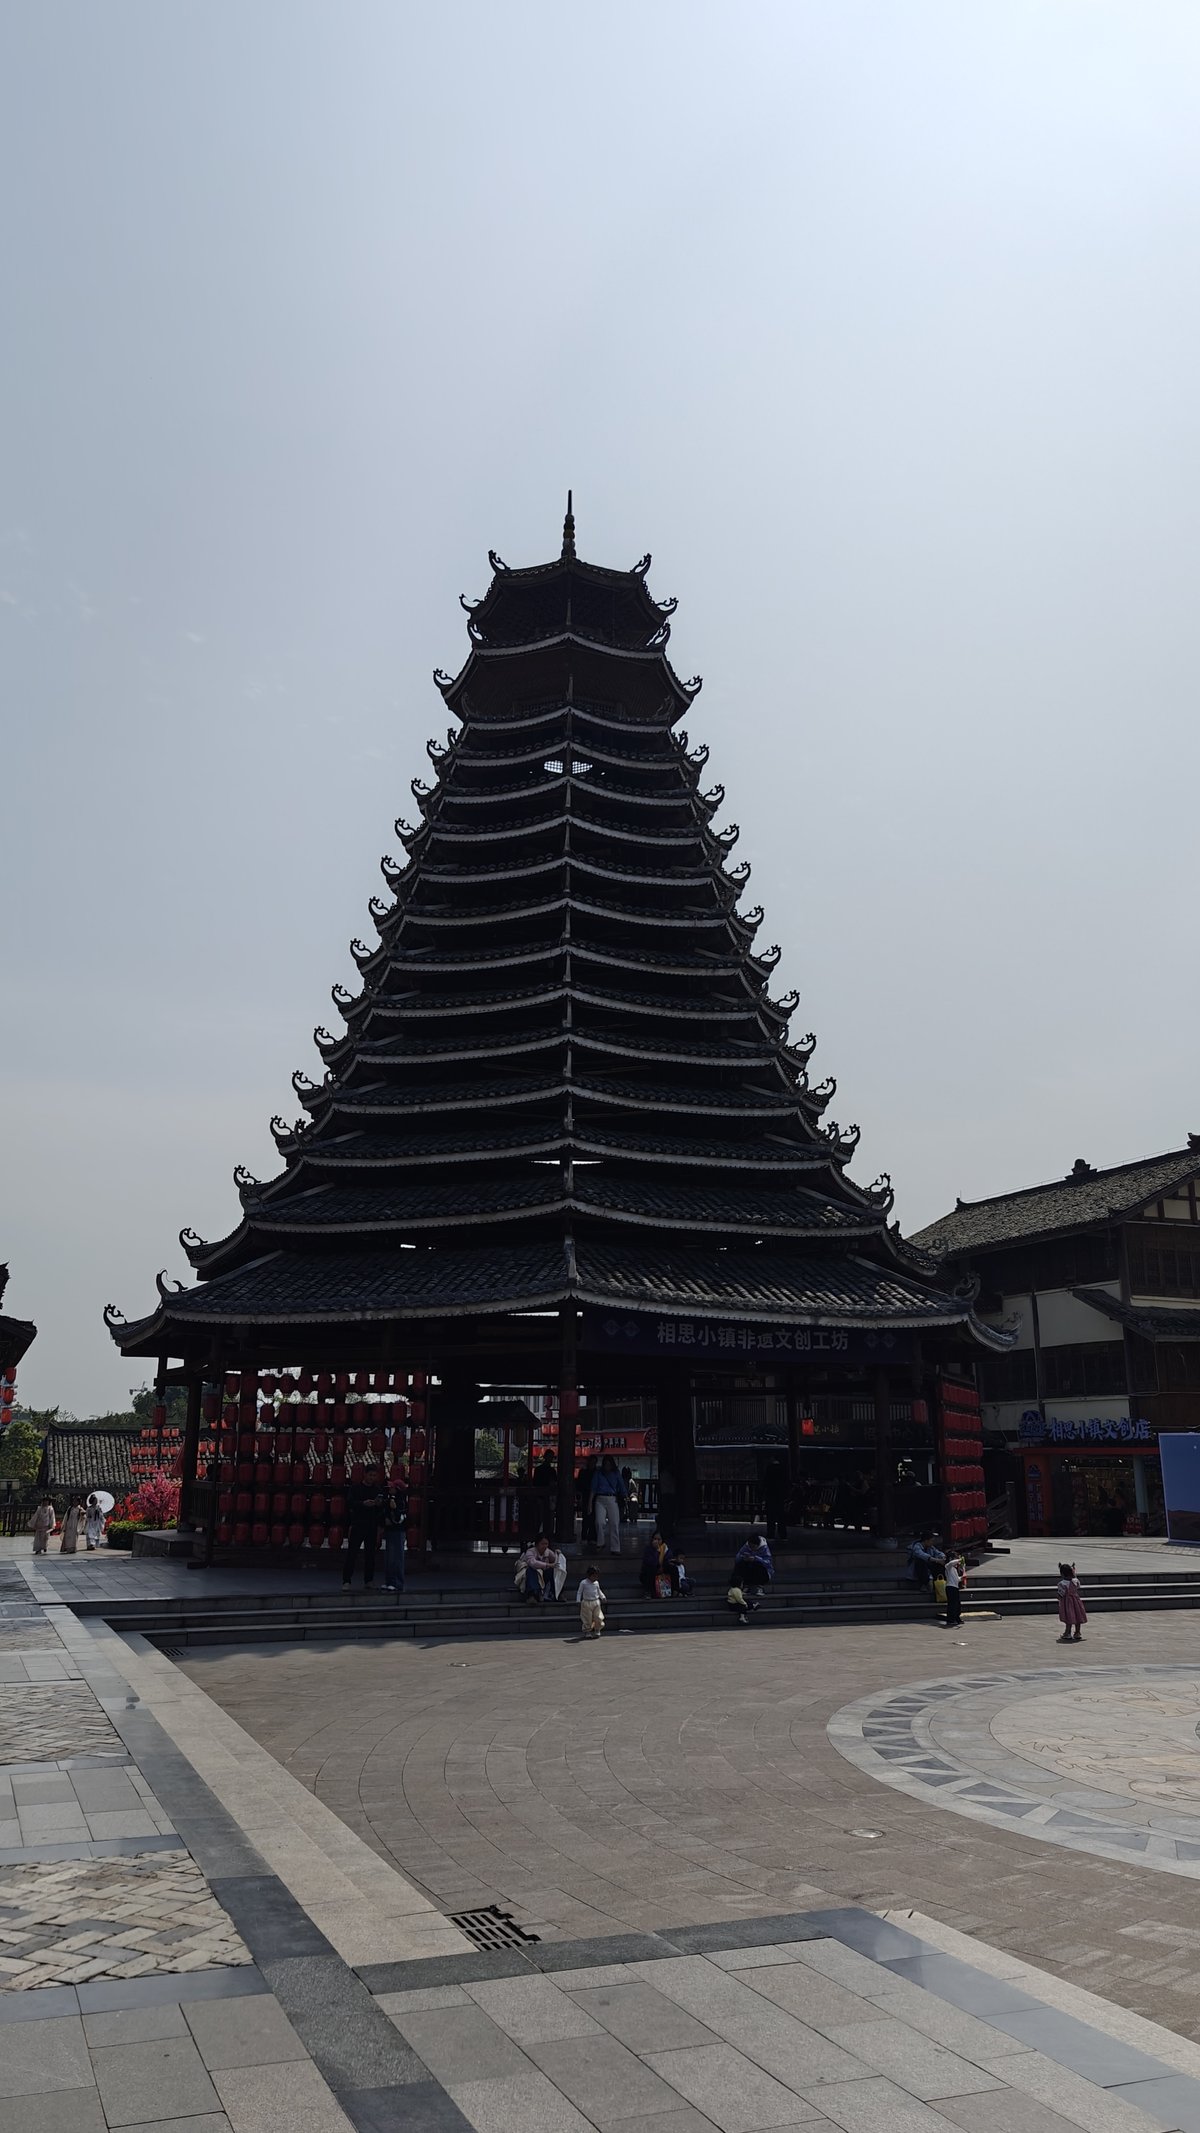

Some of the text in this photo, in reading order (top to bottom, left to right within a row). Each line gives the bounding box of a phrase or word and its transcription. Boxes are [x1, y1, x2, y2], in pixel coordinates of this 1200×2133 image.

[657, 1321, 849, 1351] 相思小镇非遗文创工坊
